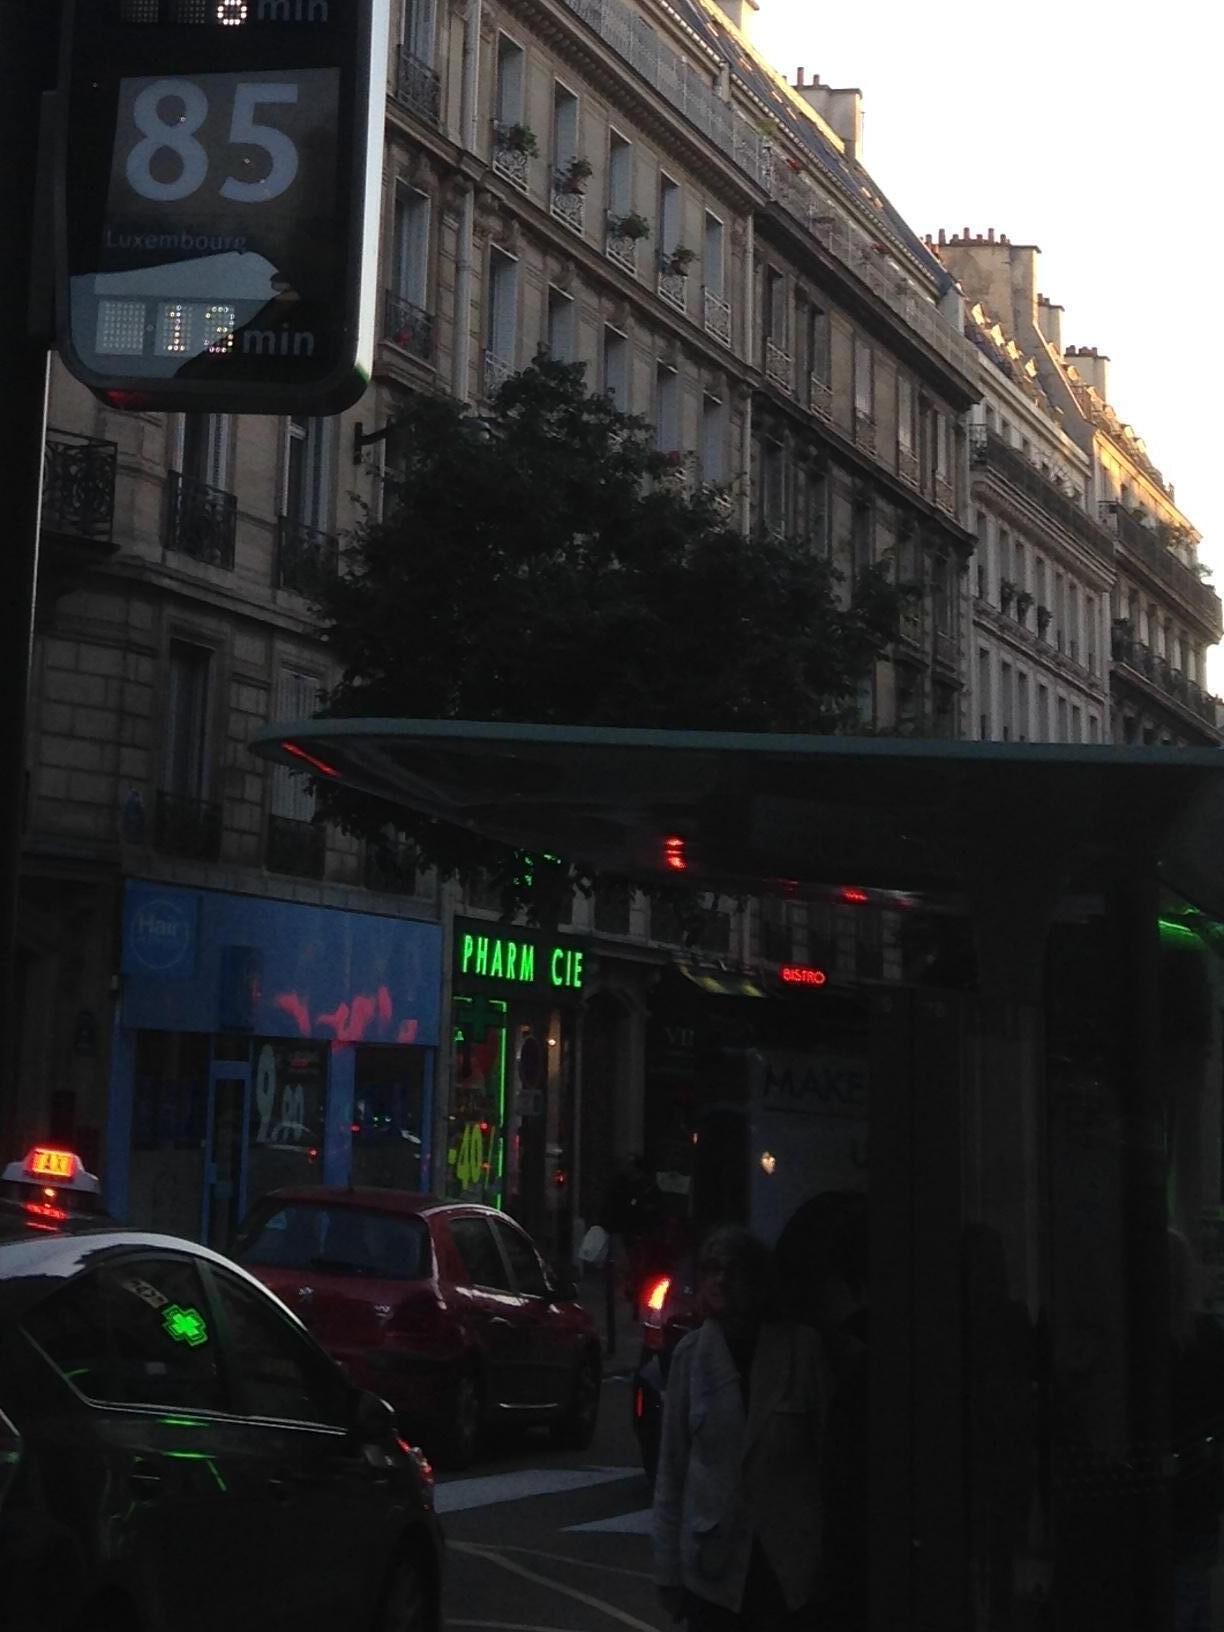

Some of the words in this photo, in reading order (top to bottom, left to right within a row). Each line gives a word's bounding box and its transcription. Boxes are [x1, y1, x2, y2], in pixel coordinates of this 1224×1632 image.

[126, 78, 299, 203] 85
[105, 230, 247, 252] Luxembourg
[242, 322, 315, 356] min
[782, 967, 826, 984] BISTRO
